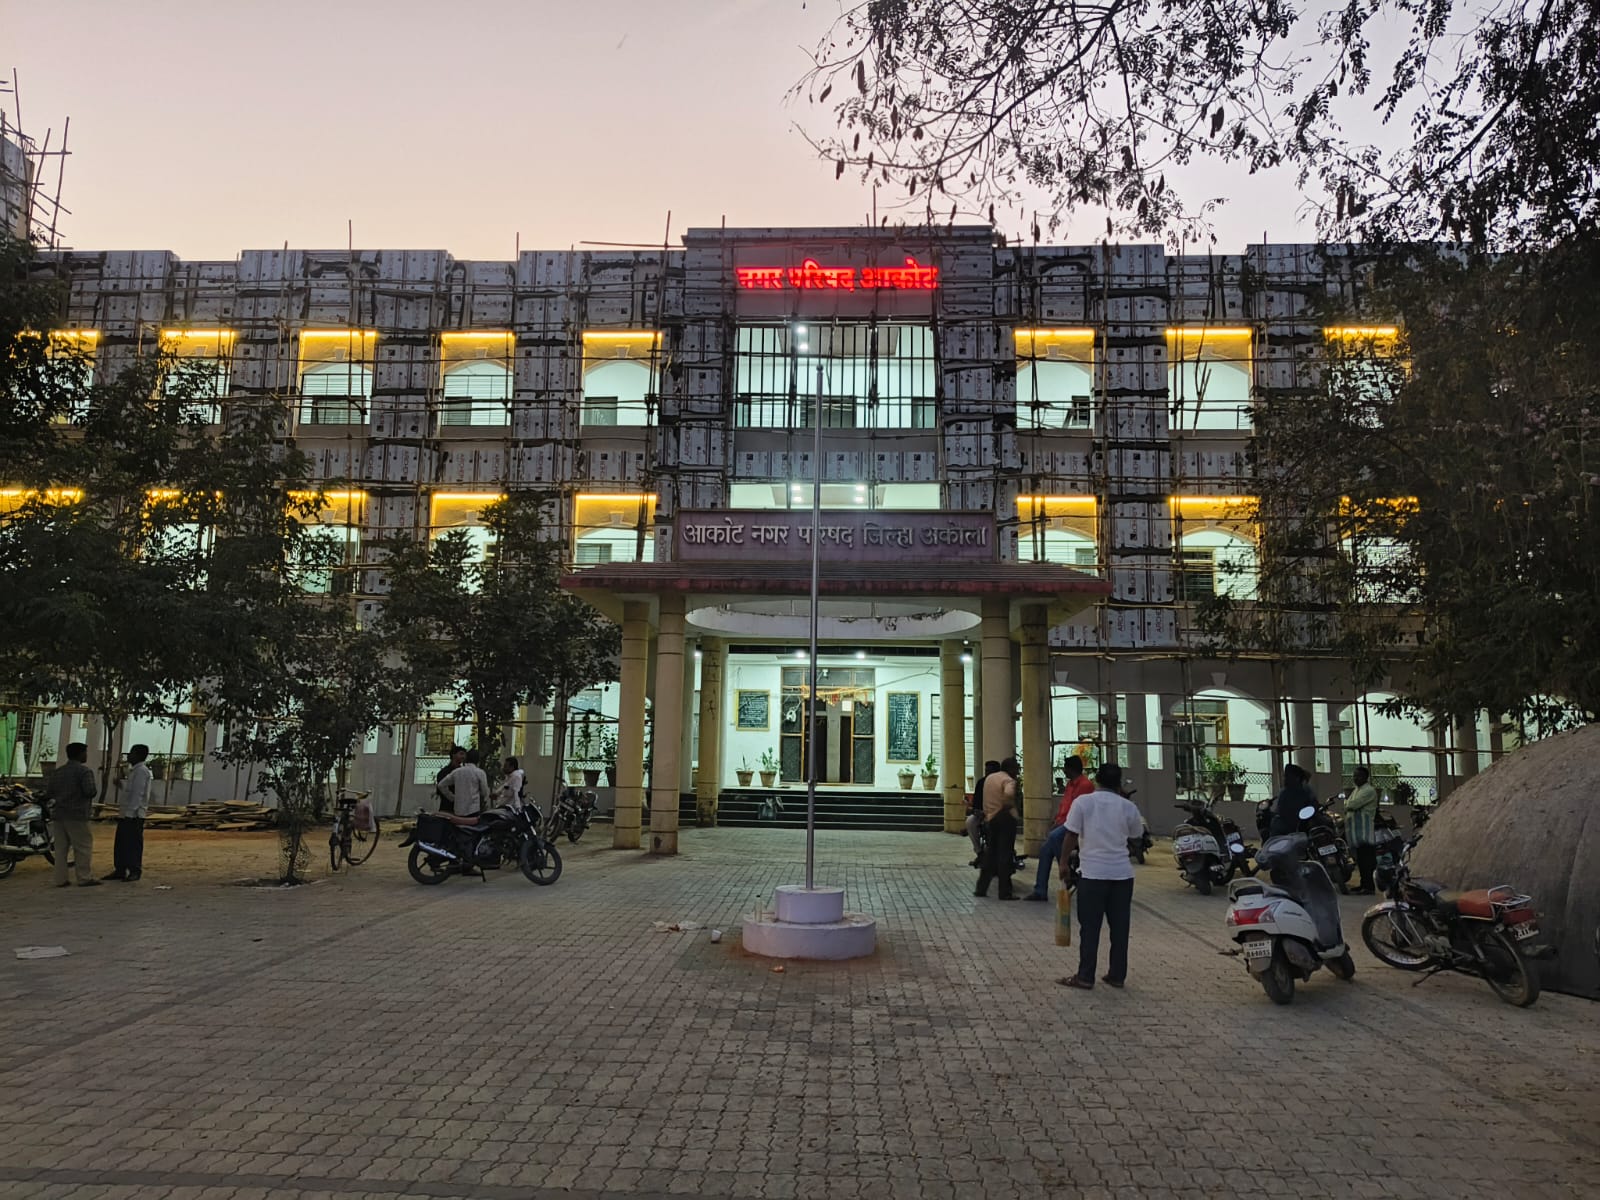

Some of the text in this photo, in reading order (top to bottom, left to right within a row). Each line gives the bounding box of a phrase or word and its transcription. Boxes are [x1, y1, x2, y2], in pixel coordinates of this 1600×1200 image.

[736, 256, 939, 292] नगर परिषद आकोट
[683, 517, 744, 544] आकोट
[751, 525, 789, 544] नगर
[863, 521, 913, 549] जिल्हा
[920, 520, 986, 546] अकोला
